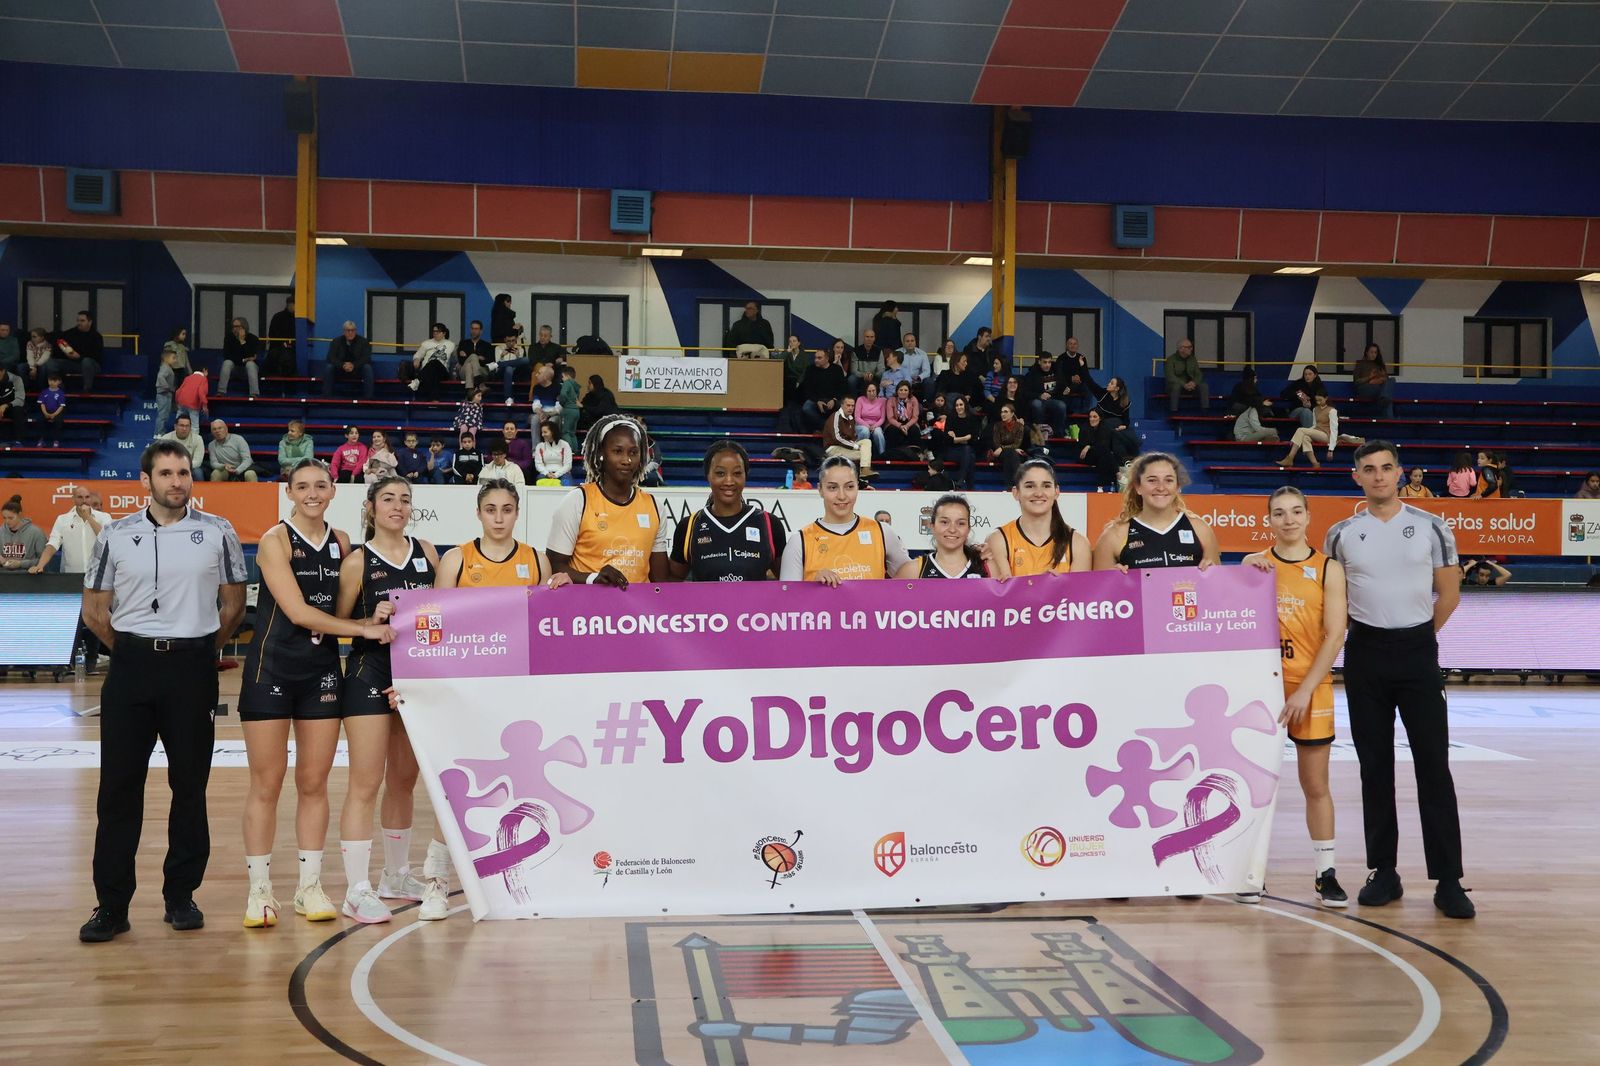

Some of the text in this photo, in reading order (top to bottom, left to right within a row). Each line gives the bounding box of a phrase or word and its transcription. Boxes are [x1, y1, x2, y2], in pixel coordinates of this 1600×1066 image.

[645, 367, 723, 377] AYUNTAMIENTO
[644, 378, 722, 390] DE ZAMORA
[1201, 508, 1256, 527] oletas
[1490, 512, 1536, 531] salud
[1478, 534, 1535, 544] ZAMORA
[733, 549, 760, 559] Cajasol
[1168, 553, 1194, 562] Cajasol
[538, 598, 1134, 636] EL BALONCESTO CONTRA LA VIOLENCIA DE GÉNERO
[1201, 607, 1256, 619] Junta de
[1166, 619, 1257, 634] Castilla y León
[446, 632, 507, 644] Junta de
[408, 644, 507, 659] Castilla y León
[592, 689, 1098, 774] #YoDigoCero
[1069, 834, 1105, 843] UNIVERSO
[910, 841, 978, 856] baloncesto
[1069, 842, 1105, 851] MUJER
[1069, 850, 1106, 858] BALONCESTO
[615, 858, 650, 866] Federación
[661, 857, 696, 865] Baloncesto
